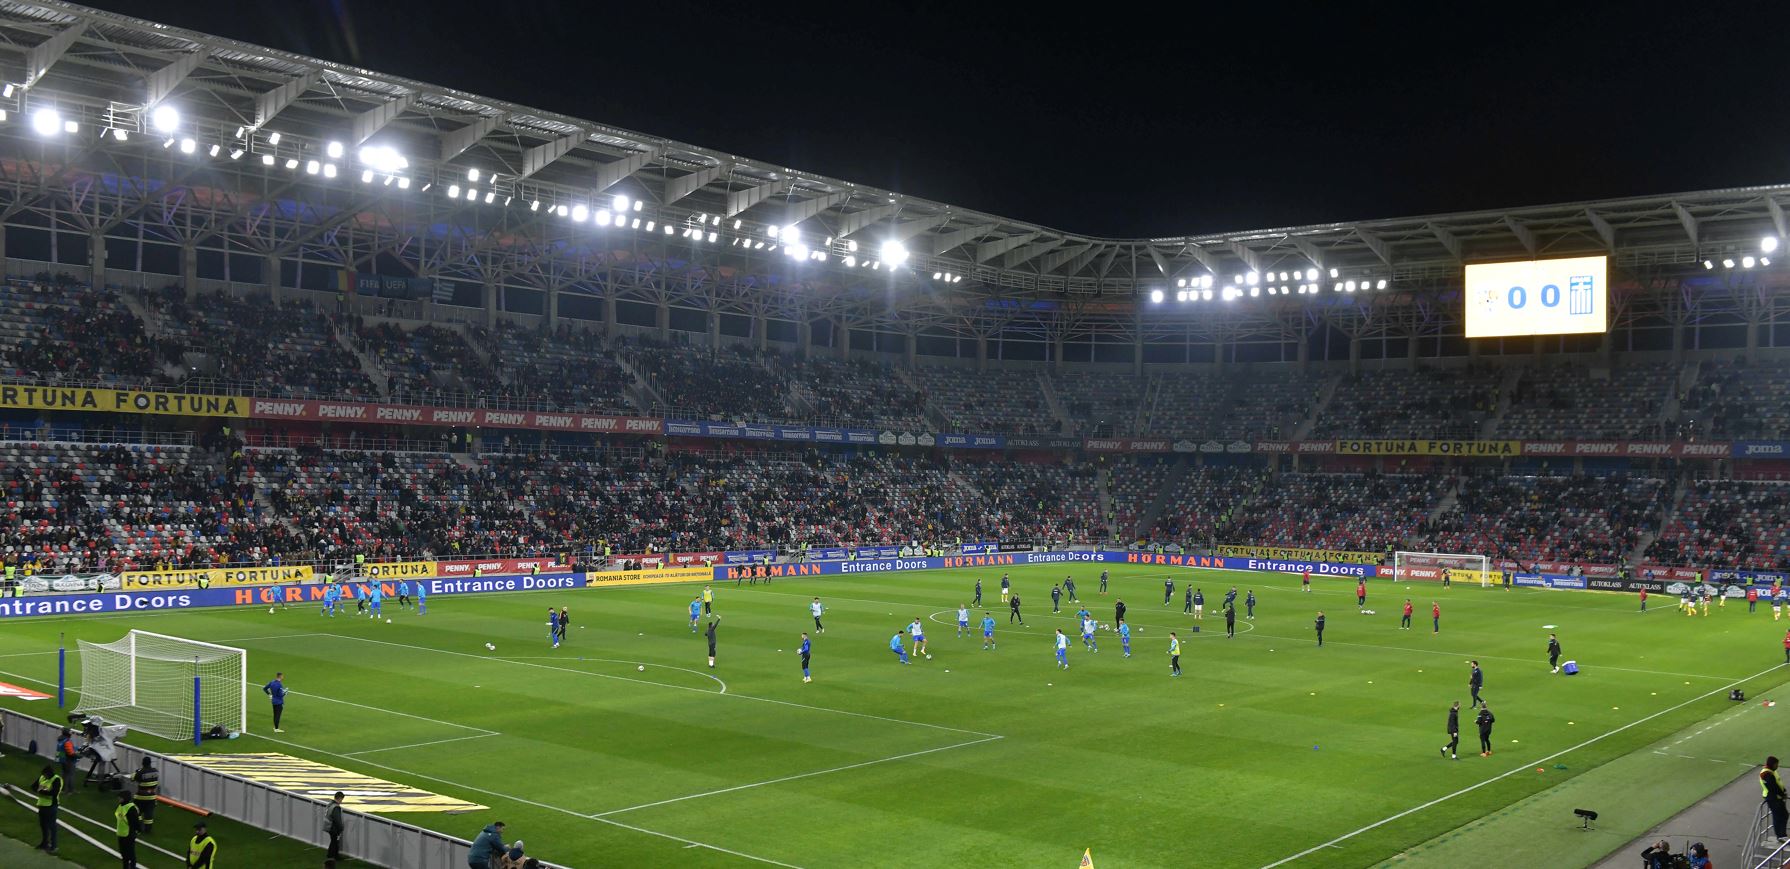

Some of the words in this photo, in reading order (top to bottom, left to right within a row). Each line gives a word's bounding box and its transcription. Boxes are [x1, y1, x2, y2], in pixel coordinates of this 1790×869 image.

[360, 280, 380, 288] FIFA
[1508, 286, 1526, 309] 0
[1541, 284, 1560, 307] 0
[116, 392, 238, 415] FORTUNA
[1340, 441, 1417, 453] FORTUNA
[1428, 442, 1512, 454] FORTUNA
[1028, 554, 1065, 562] Entrance
[842, 561, 892, 572] Entrance
[896, 559, 927, 570] Doors
[1248, 560, 1313, 572] Entrance
[1319, 563, 1364, 575] Doors
[225, 569, 303, 582] FORTUNA
[431, 578, 515, 594] Entrance
[523, 576, 574, 589] Doors
